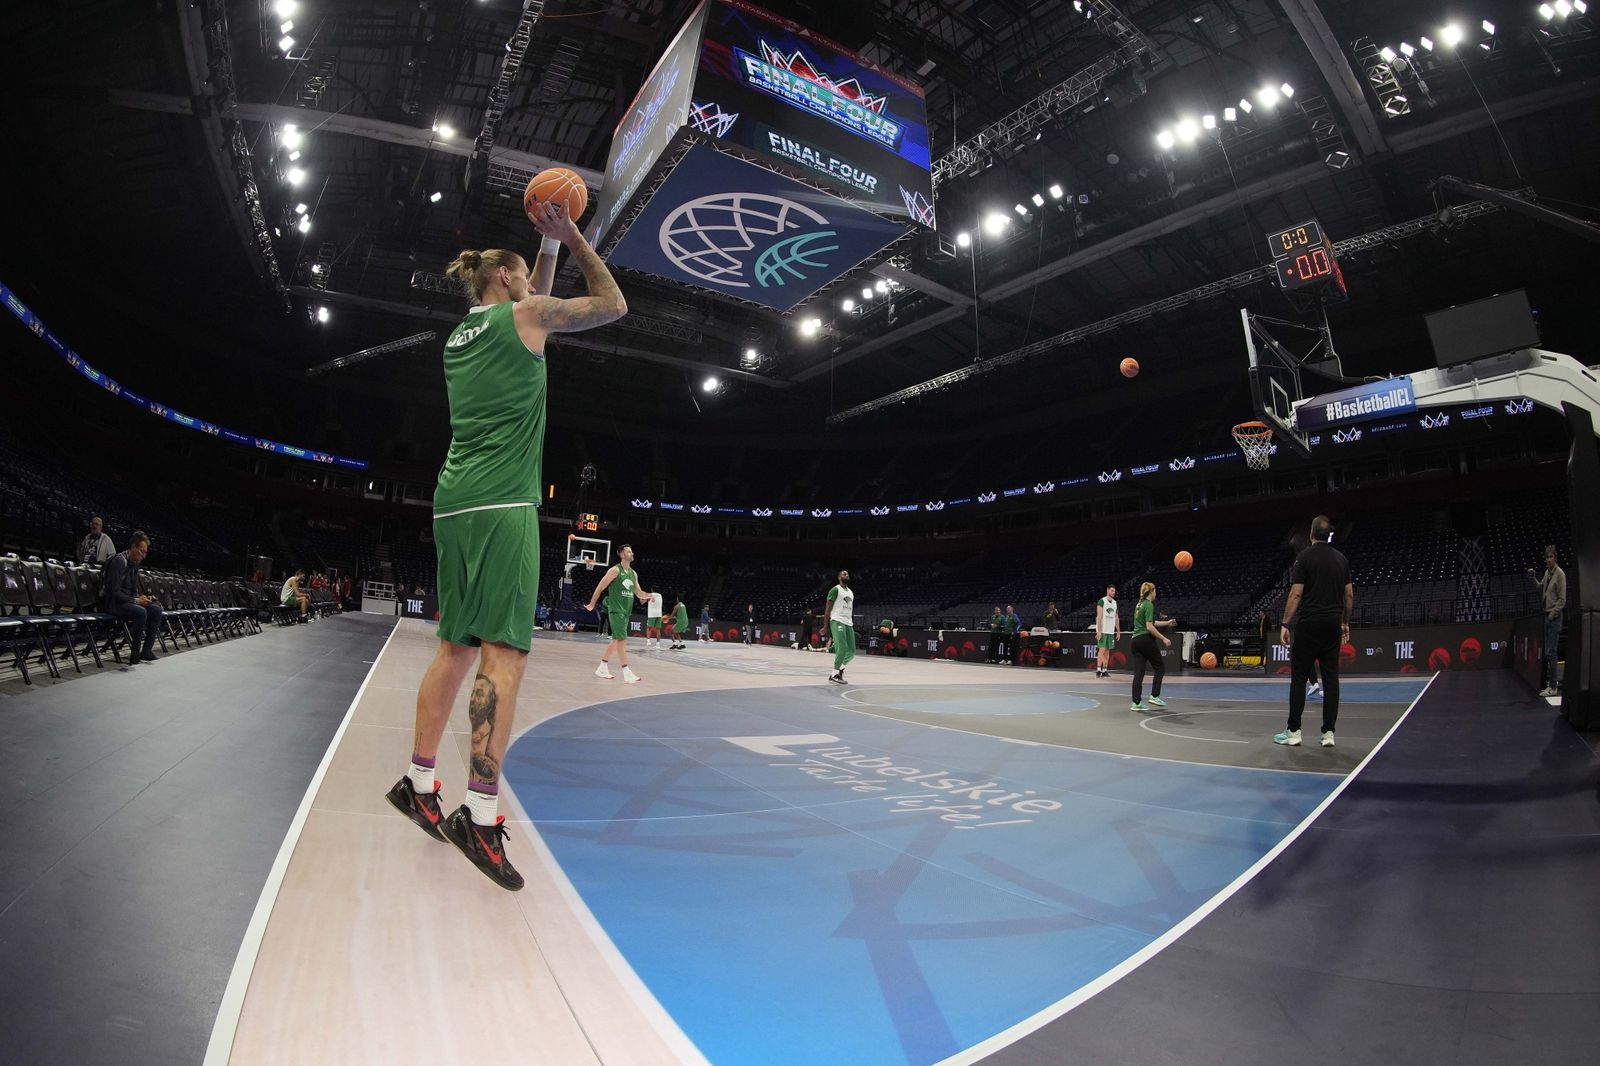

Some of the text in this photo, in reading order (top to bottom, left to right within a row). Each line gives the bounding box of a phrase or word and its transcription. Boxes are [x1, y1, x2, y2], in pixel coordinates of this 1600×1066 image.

[744, 56, 898, 140] FINAL FOUR
[749, 76, 894, 147] BASKETBALL CHAMPIONS LEAGUE
[768, 131, 878, 189] FINAL FOUR
[771, 147, 875, 195] BASKETBALL CHAMPIONS LEAGUE
[1281, 228, 1308, 249] 0:0
[1326, 388, 1412, 421] #BasketballCL
[407, 599, 423, 614] THE
[630, 621, 641, 631] THE
[927, 640, 938, 652] THE
[1272, 645, 1291, 661] THE
[1394, 641, 1415, 660] THE
[720, 734, 1063, 813] Lubelskie
